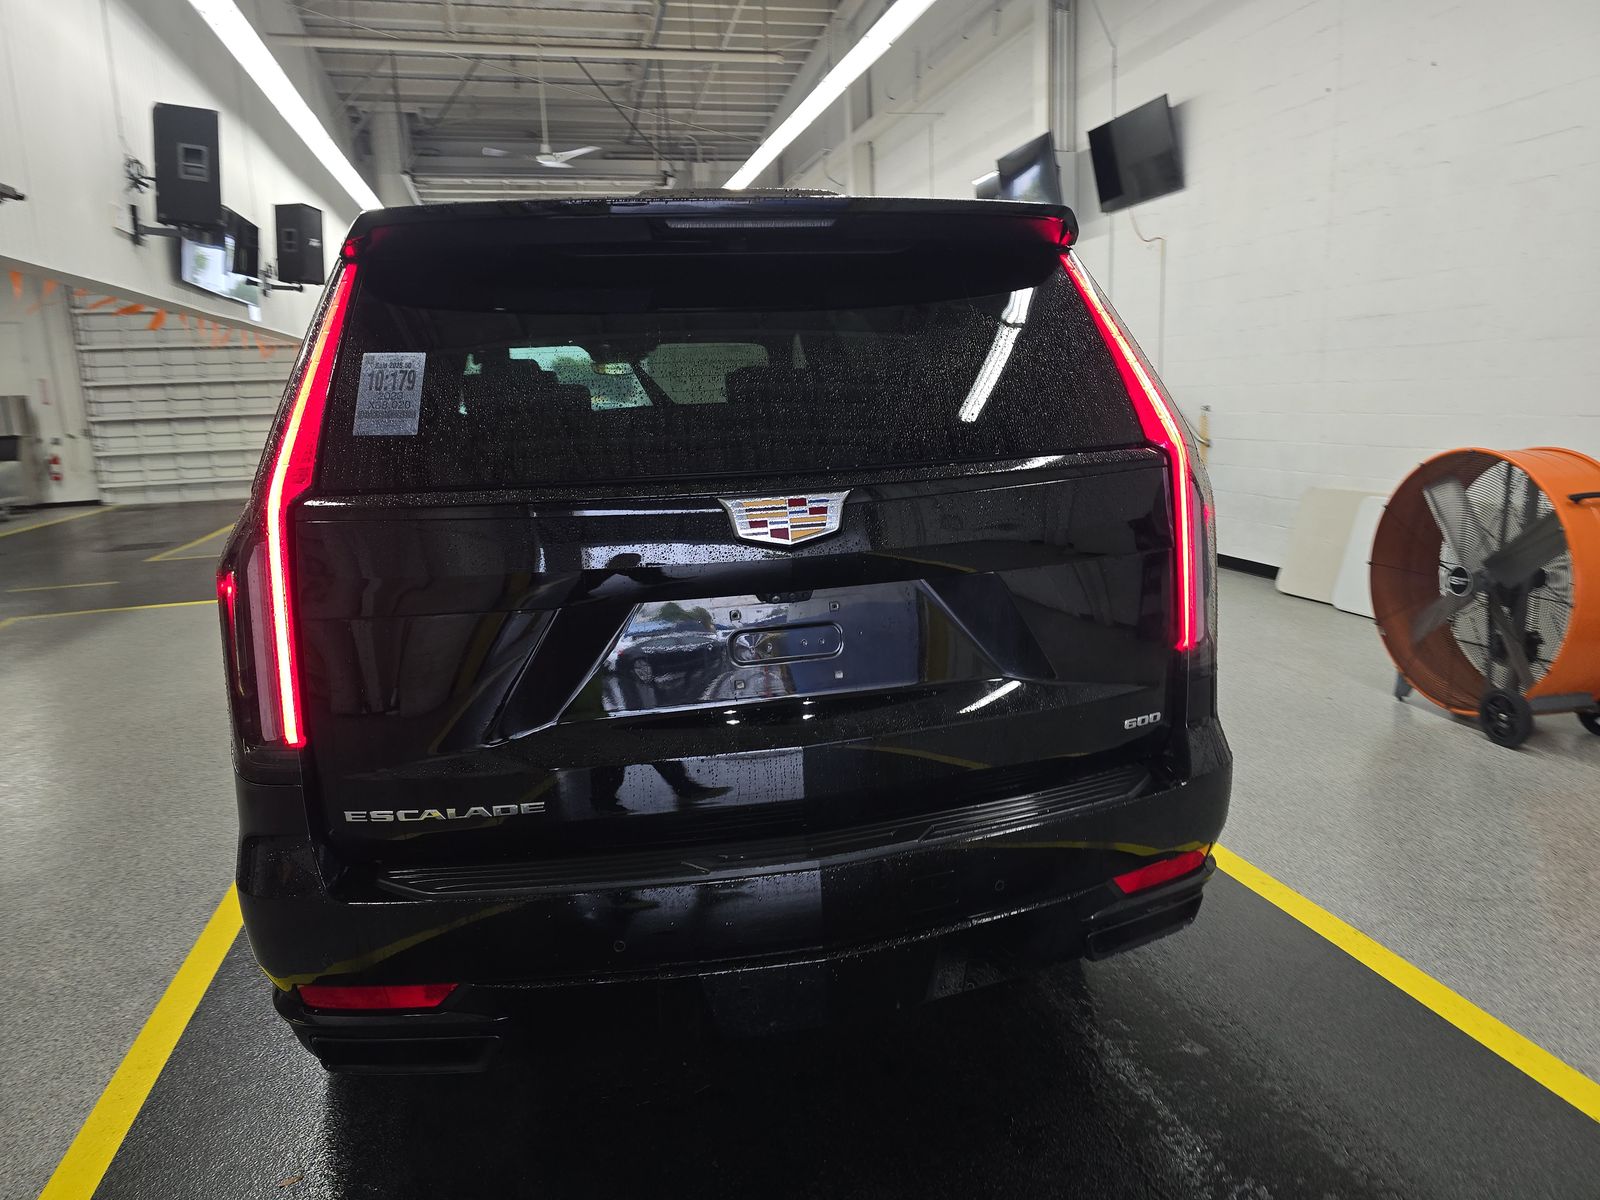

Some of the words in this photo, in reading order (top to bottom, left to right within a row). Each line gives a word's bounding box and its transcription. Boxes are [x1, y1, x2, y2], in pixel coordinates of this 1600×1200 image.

[368, 369, 417, 391] 10:179
[377, 391, 404, 401] 2023
[1124, 711, 1162, 730] 600
[343, 801, 546, 823] ESCALADE
